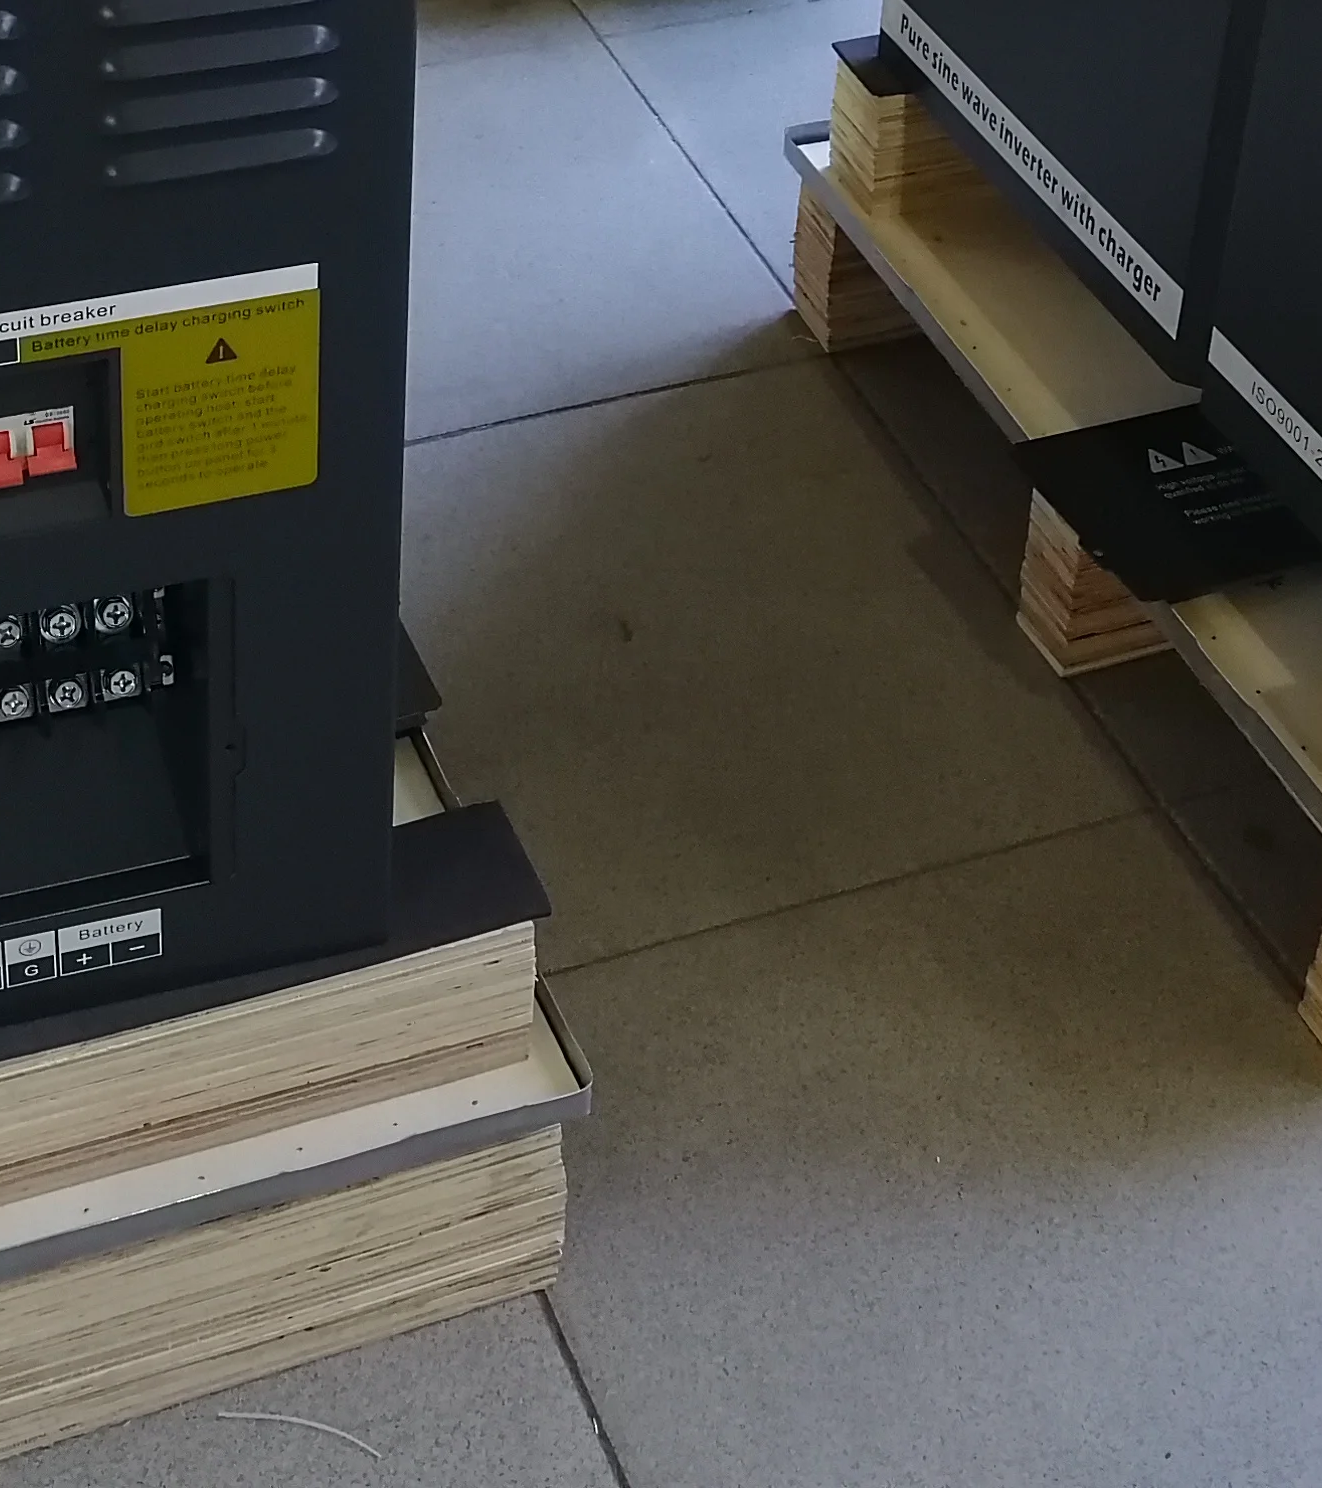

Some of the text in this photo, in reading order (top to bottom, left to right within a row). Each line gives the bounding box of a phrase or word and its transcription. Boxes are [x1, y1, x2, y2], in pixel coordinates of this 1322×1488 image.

[900, 13, 1161, 301] Pure sine wave inverter with charger
[31, 297, 305, 353] Battery time delay charging switch
[40, 302, 117, 327] breaker
[78, 918, 144, 941] Battery
[24, 964, 39, 978] G
